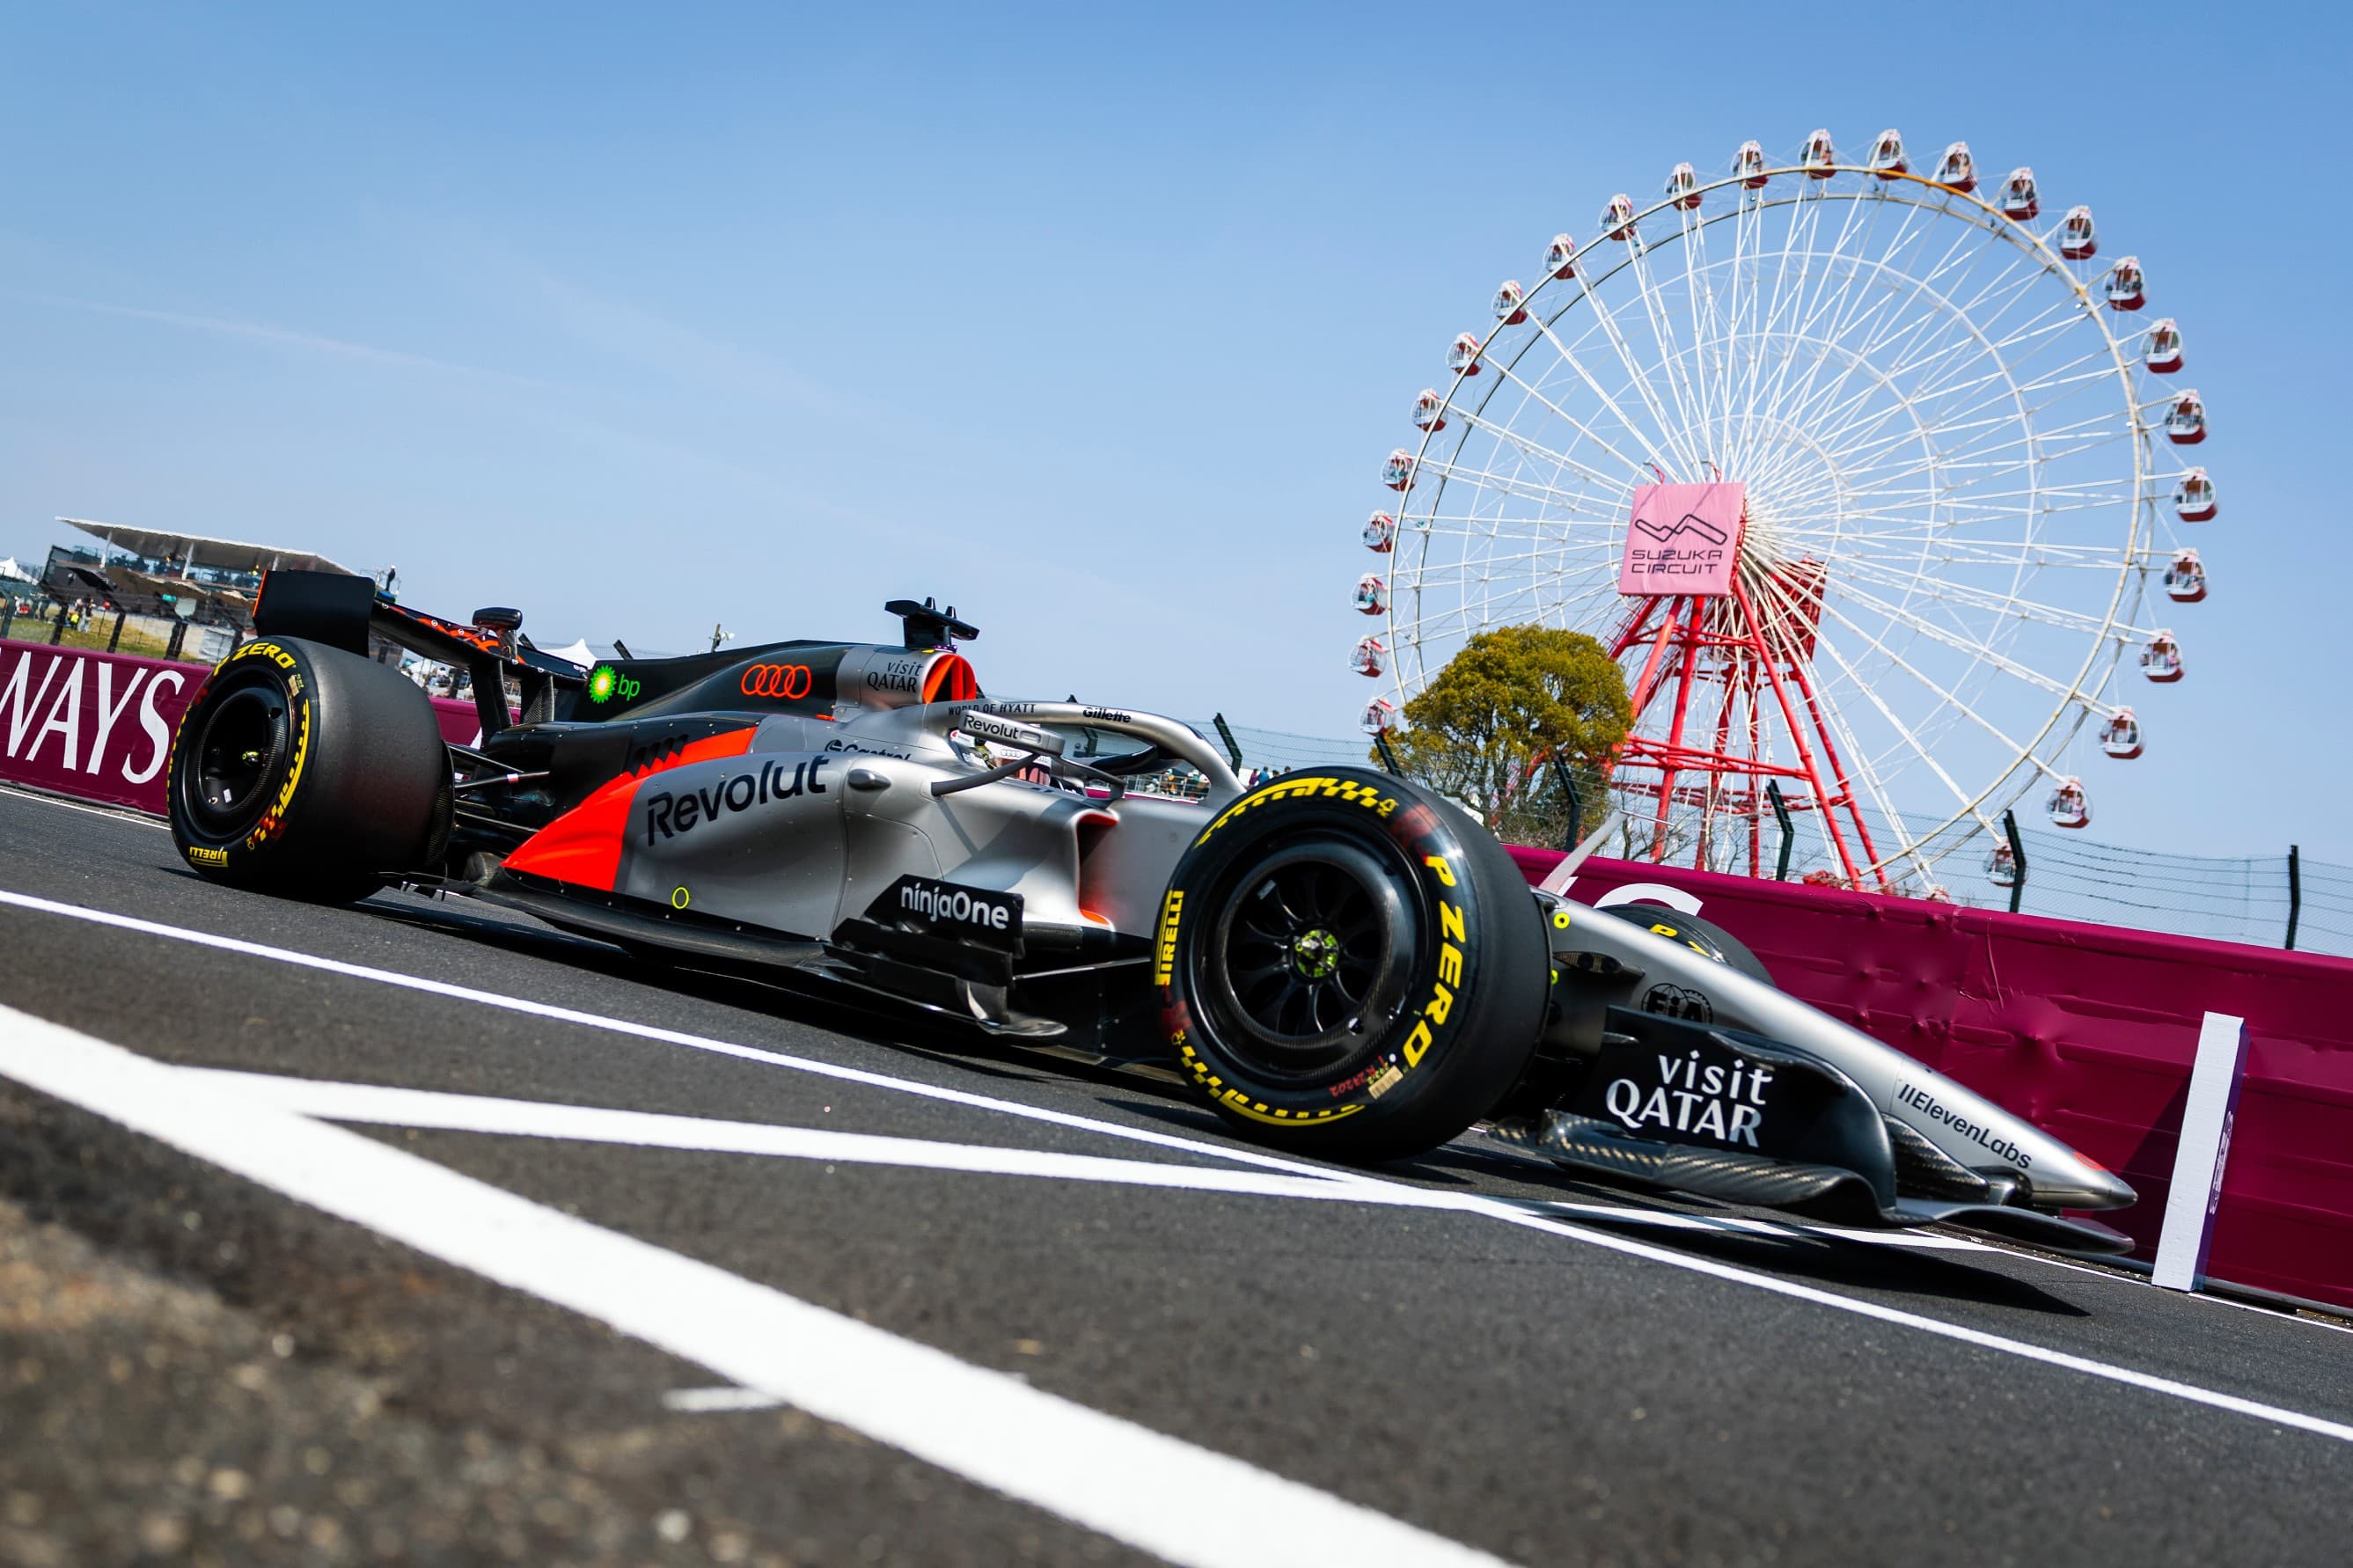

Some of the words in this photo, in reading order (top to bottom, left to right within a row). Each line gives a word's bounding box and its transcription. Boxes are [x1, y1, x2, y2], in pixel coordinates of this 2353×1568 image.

[1631, 549, 1722, 560] SUZUKA
[1631, 563, 1718, 574] CIRCUIT
[231, 642, 296, 669] ZERO
[887, 660, 923, 676] visit
[618, 674, 641, 700] bp
[867, 671, 917, 693] QATAR
[983, 703, 996, 713] OF
[1000, 703, 1036, 714] HYATT
[1083, 707, 1132, 723] Gillette
[964, 714, 1019, 739] Revolut
[648, 754, 831, 846] Revolut
[190, 846, 229, 868] PIRELLI
[1425, 855, 1457, 887] P
[901, 883, 1008, 929] ninjaOne
[1155, 890, 1184, 985] PIRELLI
[1403, 900, 1466, 1068] ZERO
[1658, 1050, 1773, 1105] visit
[1606, 1079, 1762, 1148] QATAR
